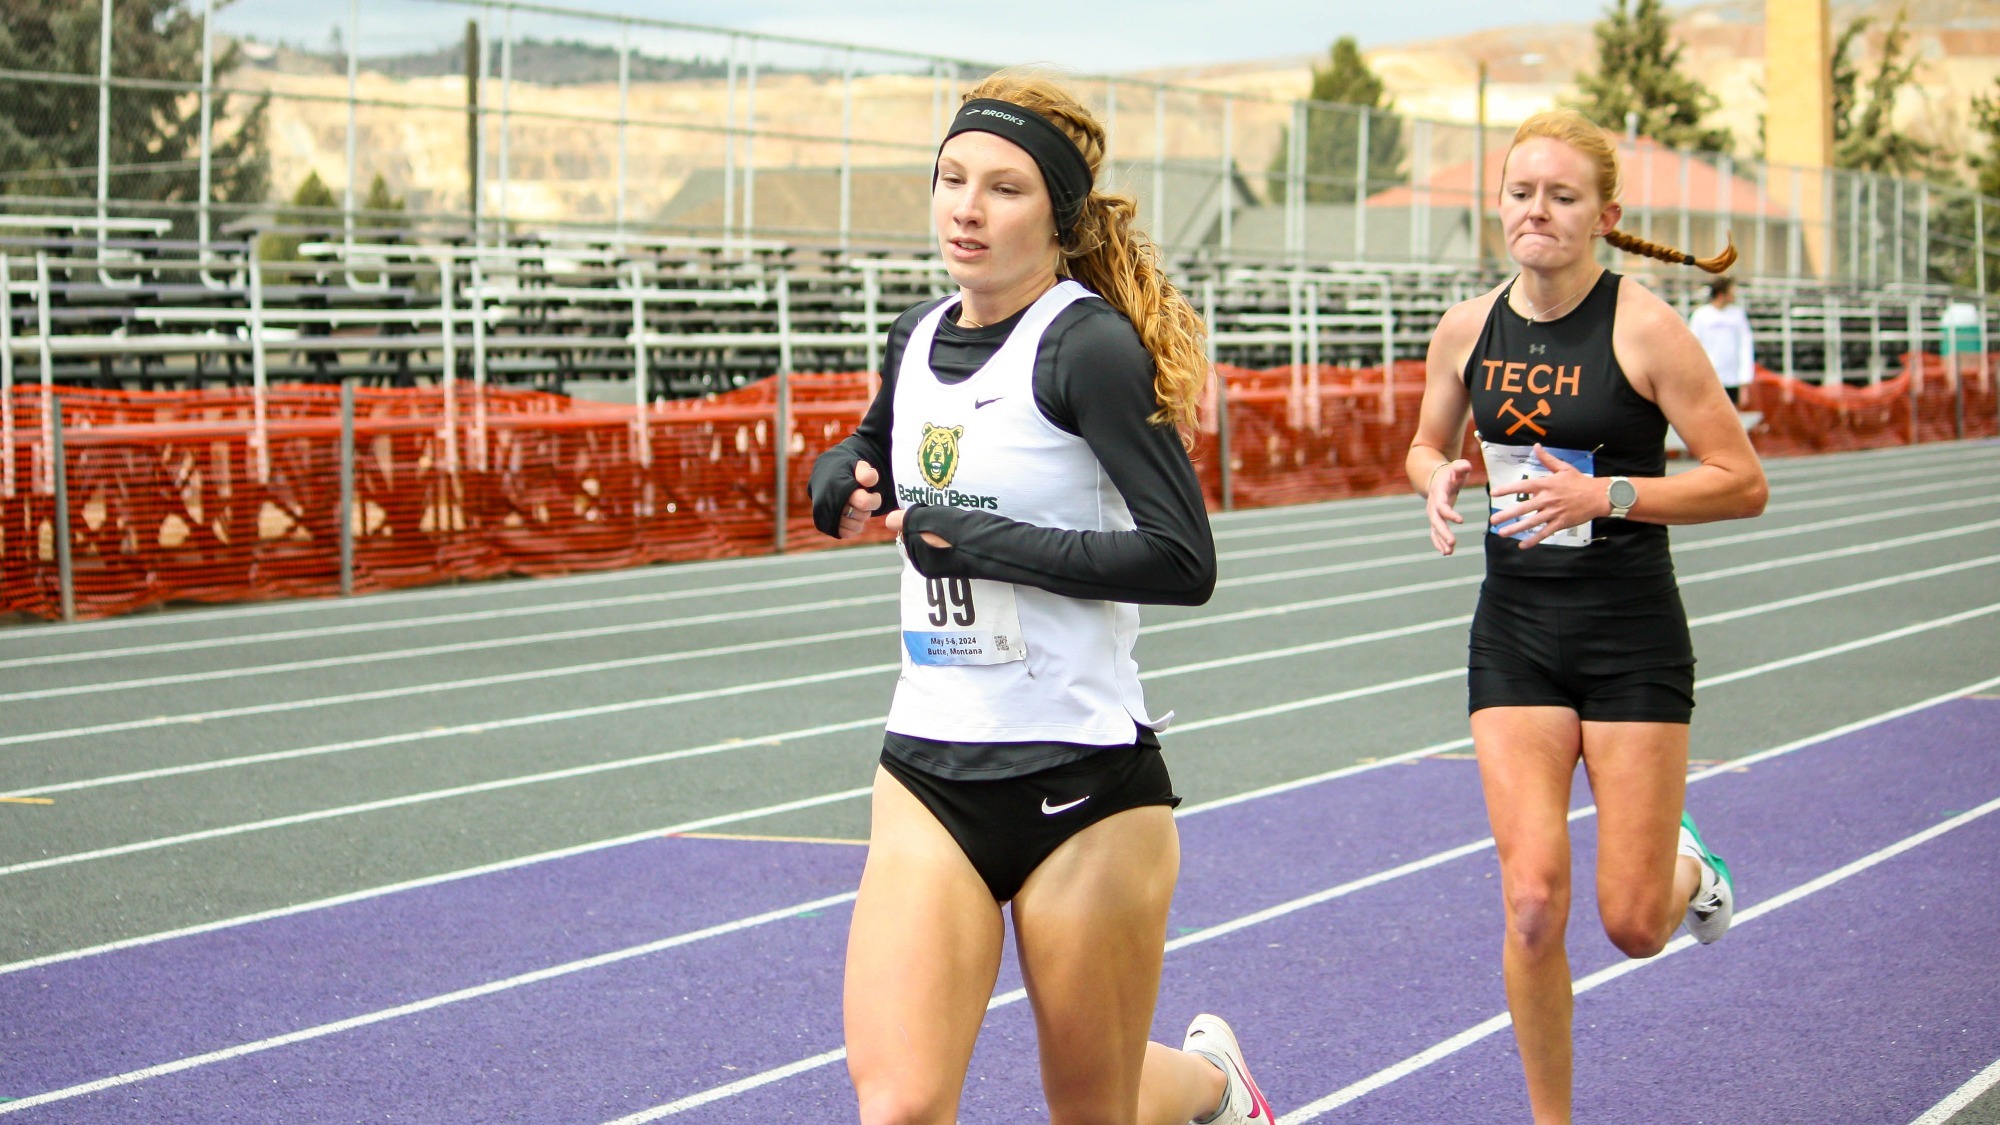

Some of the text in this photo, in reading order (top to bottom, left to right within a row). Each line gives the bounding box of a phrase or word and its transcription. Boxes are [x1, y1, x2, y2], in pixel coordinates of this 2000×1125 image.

[981, 109, 1025, 126] BROOKS
[1482, 359, 1581, 396] TECH
[926, 577, 976, 627] 99
[930, 637, 977, 646] May 5-6, 2024
[927, 647, 949, 656] Butte,
